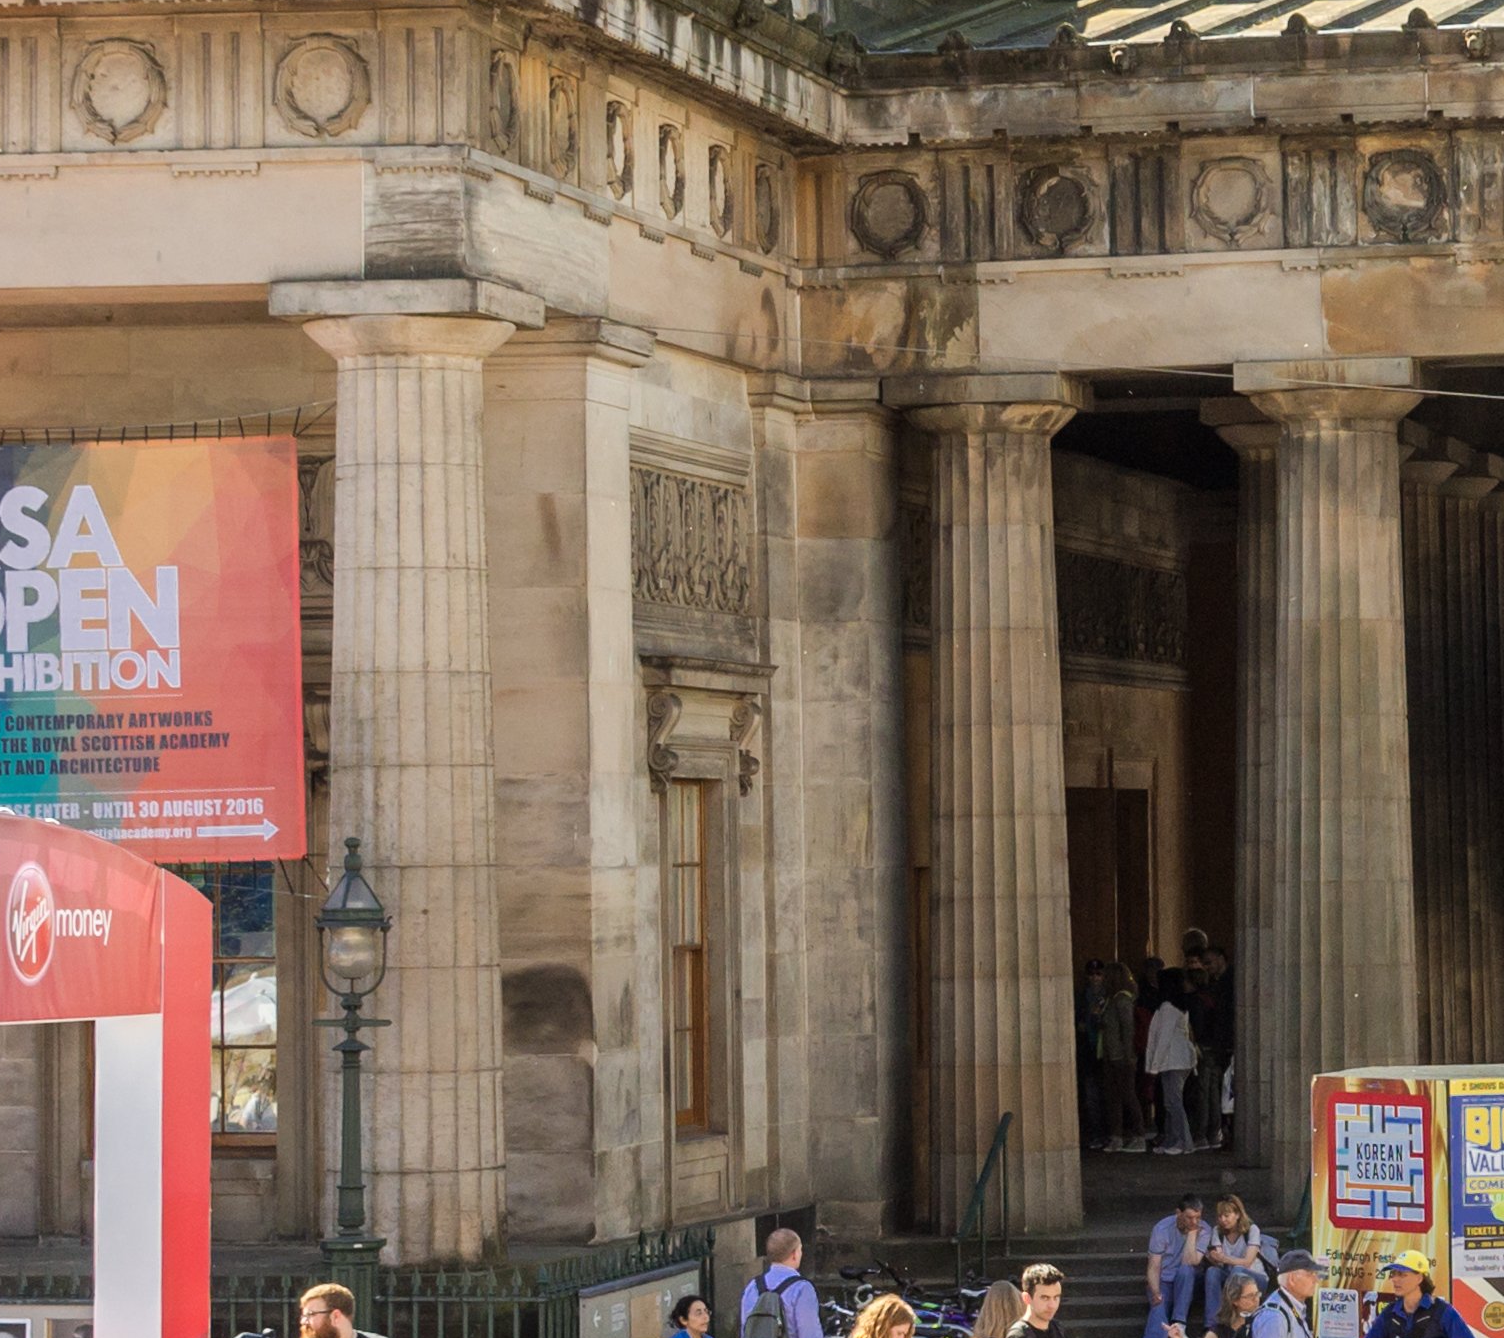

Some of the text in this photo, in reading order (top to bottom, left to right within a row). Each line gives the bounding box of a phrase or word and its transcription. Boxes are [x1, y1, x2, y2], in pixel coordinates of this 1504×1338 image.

[5, 713, 123, 731] CONTEMPORARY
[129, 710, 213, 728] ARTWORKS
[1, 737, 27, 753] THE
[32, 735, 76, 752] ROYAL
[82, 734, 154, 751] SCOTTISH
[159, 732, 230, 749] ACADEMY
[16, 759, 44, 775] AND
[50, 756, 160, 774] ARCHITECTURE
[35, 803, 80, 819] ENTER
[93, 801, 136, 818] UNTIL
[139, 800, 159, 818] 30
[162, 799, 223, 817] AUGUST
[226, 797, 264, 815] 2016
[11, 889, 113, 964] Virgin money
[1469, 1082, 1496, 1090] SHOWS
[1356, 1142, 1403, 1162] KOREAN
[1356, 1161, 1404, 1181] SEASON
[1466, 1225, 1497, 1236] TICKETS
[1326, 1249, 1370, 1264] Edinburgh
[1331, 1266, 1341, 1276] 04
[1344, 1267, 1364, 1278] AUG
[1321, 1292, 1355, 1301] KOREAN
[1321, 1304, 1347, 1313] STAGE
